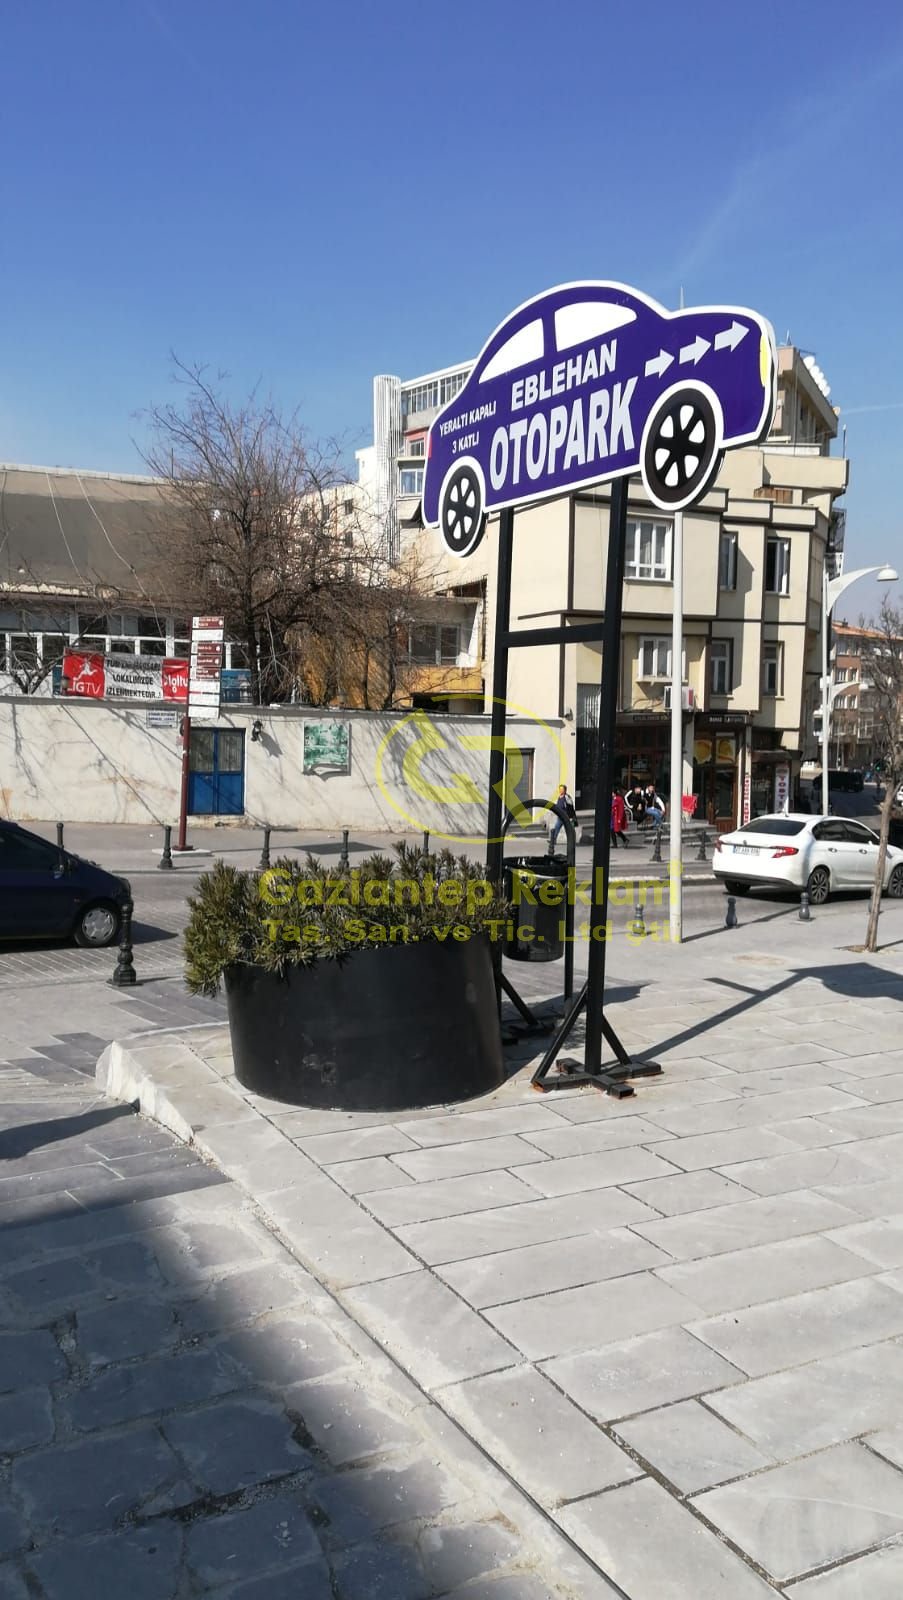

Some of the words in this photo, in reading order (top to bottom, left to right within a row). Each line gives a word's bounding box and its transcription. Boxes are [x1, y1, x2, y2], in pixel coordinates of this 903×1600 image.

[511, 339, 617, 411] EBLEHAN
[440, 412, 468, 437] YERALTI
[469, 400, 496, 424] KAPALI
[452, 440, 457, 454] 3
[458, 431, 479, 452] KATLI
[490, 376, 639, 491] OTOPARK
